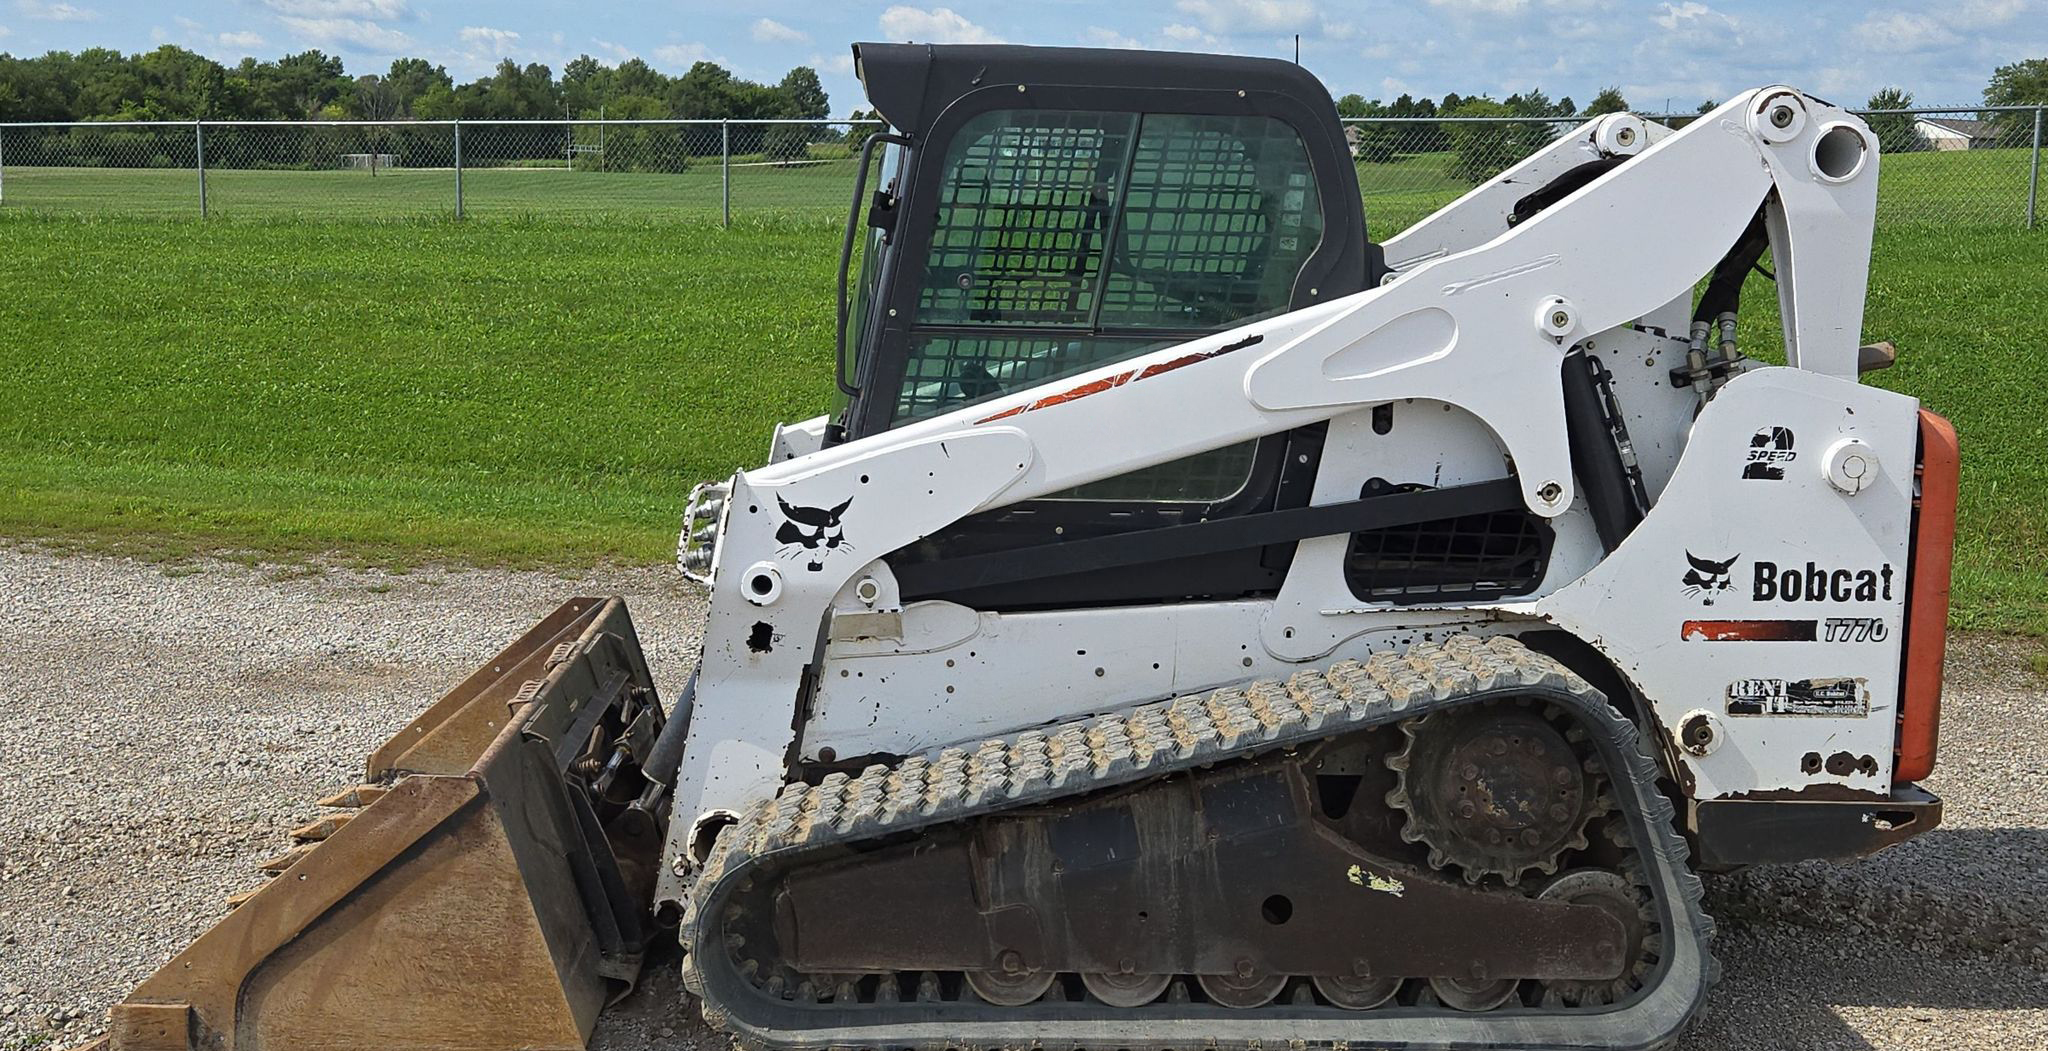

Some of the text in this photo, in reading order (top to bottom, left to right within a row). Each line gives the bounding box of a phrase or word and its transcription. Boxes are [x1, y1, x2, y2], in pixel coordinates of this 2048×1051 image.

[1746, 450, 1797, 462] SPEED
[1752, 561, 1894, 602] Bobcat
[1824, 617, 1889, 643] T770
[1730, 679, 1790, 697] RENT
[1766, 696, 1788, 713] IT
